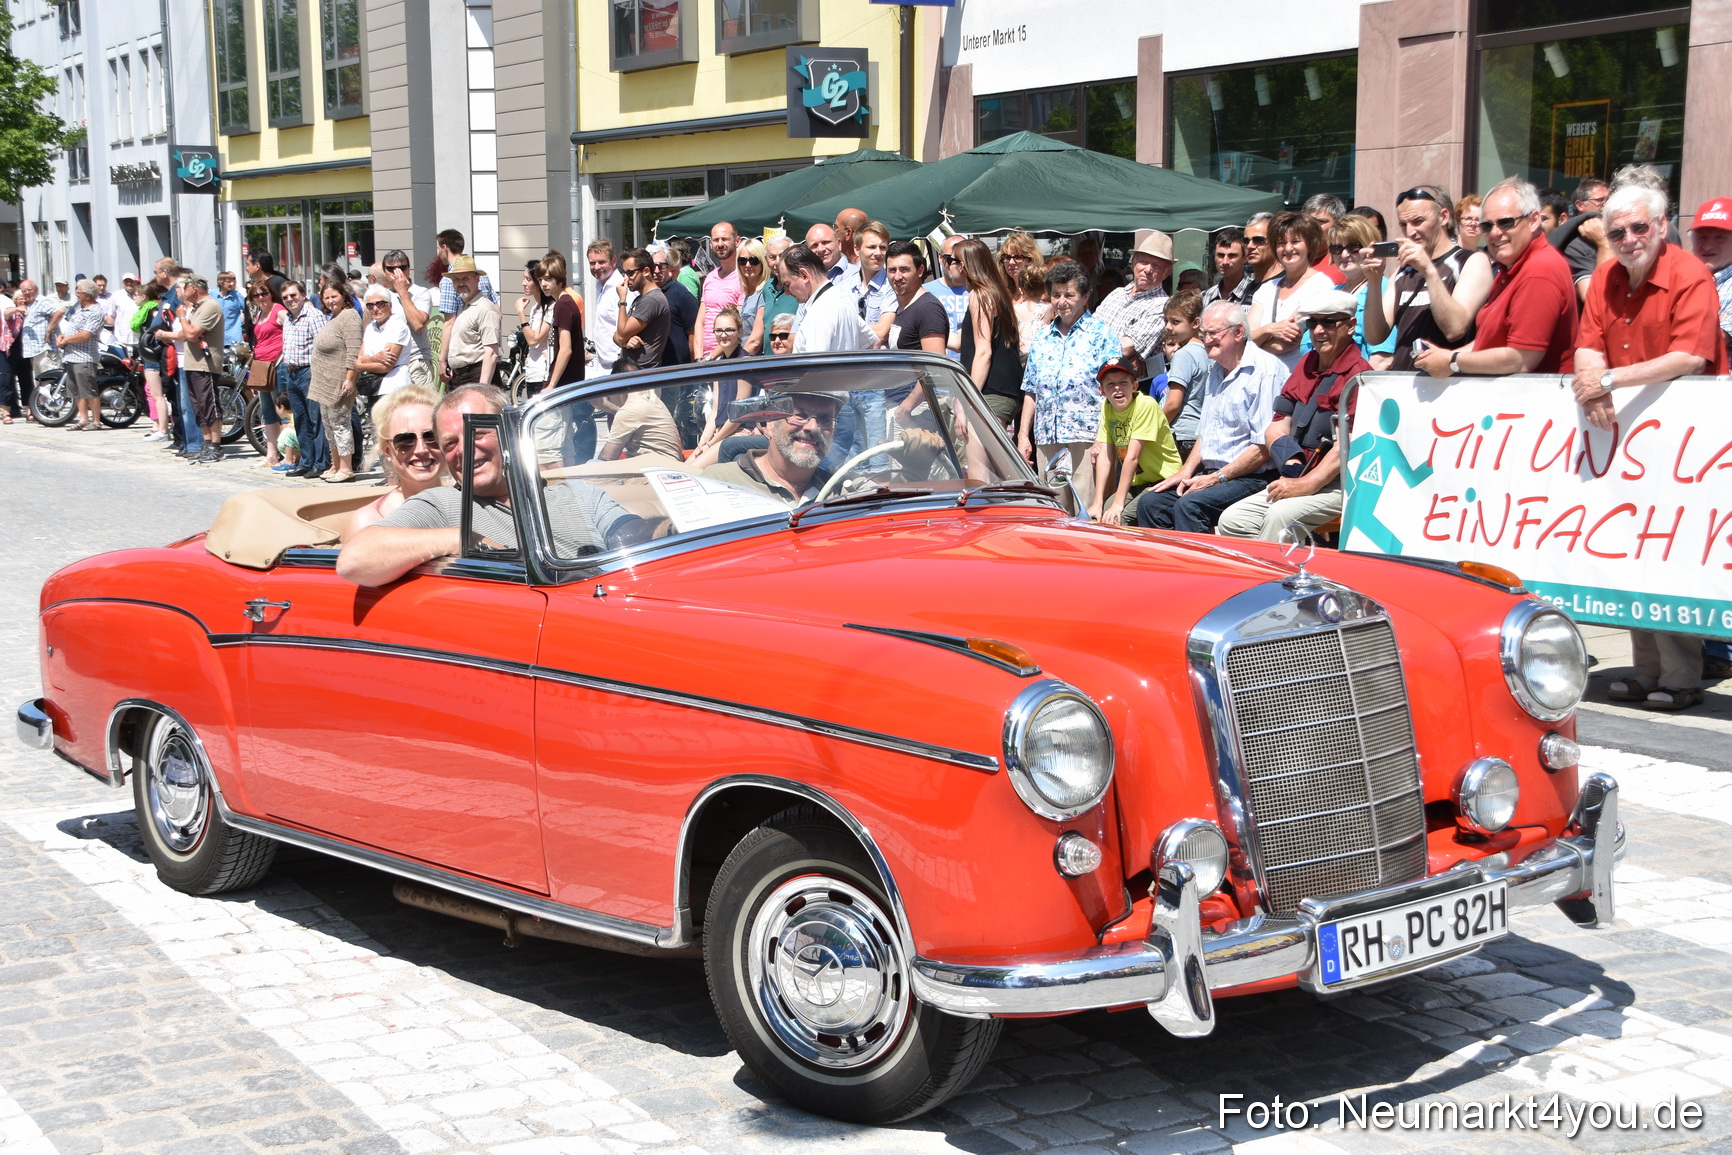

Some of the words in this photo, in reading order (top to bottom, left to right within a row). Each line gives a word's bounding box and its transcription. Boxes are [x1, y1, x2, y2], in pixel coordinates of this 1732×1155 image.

[962, 34, 991, 51] Unterer
[992, 28, 1015, 46] Markt
[1017, 24, 1027, 42] 15
[821, 72, 849, 108] G2
[1566, 122, 1597, 136] WEBER'S
[1565, 136, 1596, 157] GRILL
[188, 159, 206, 179] G2
[1564, 156, 1596, 178] BIBEL
[1530, 418, 1661, 482] UNS
[1631, 601, 1643, 620] 0
[1340, 919, 1384, 972] RH
[1405, 904, 1445, 954] PC
[1453, 886, 1506, 941] 82H
[1327, 959, 1336, 973] D
